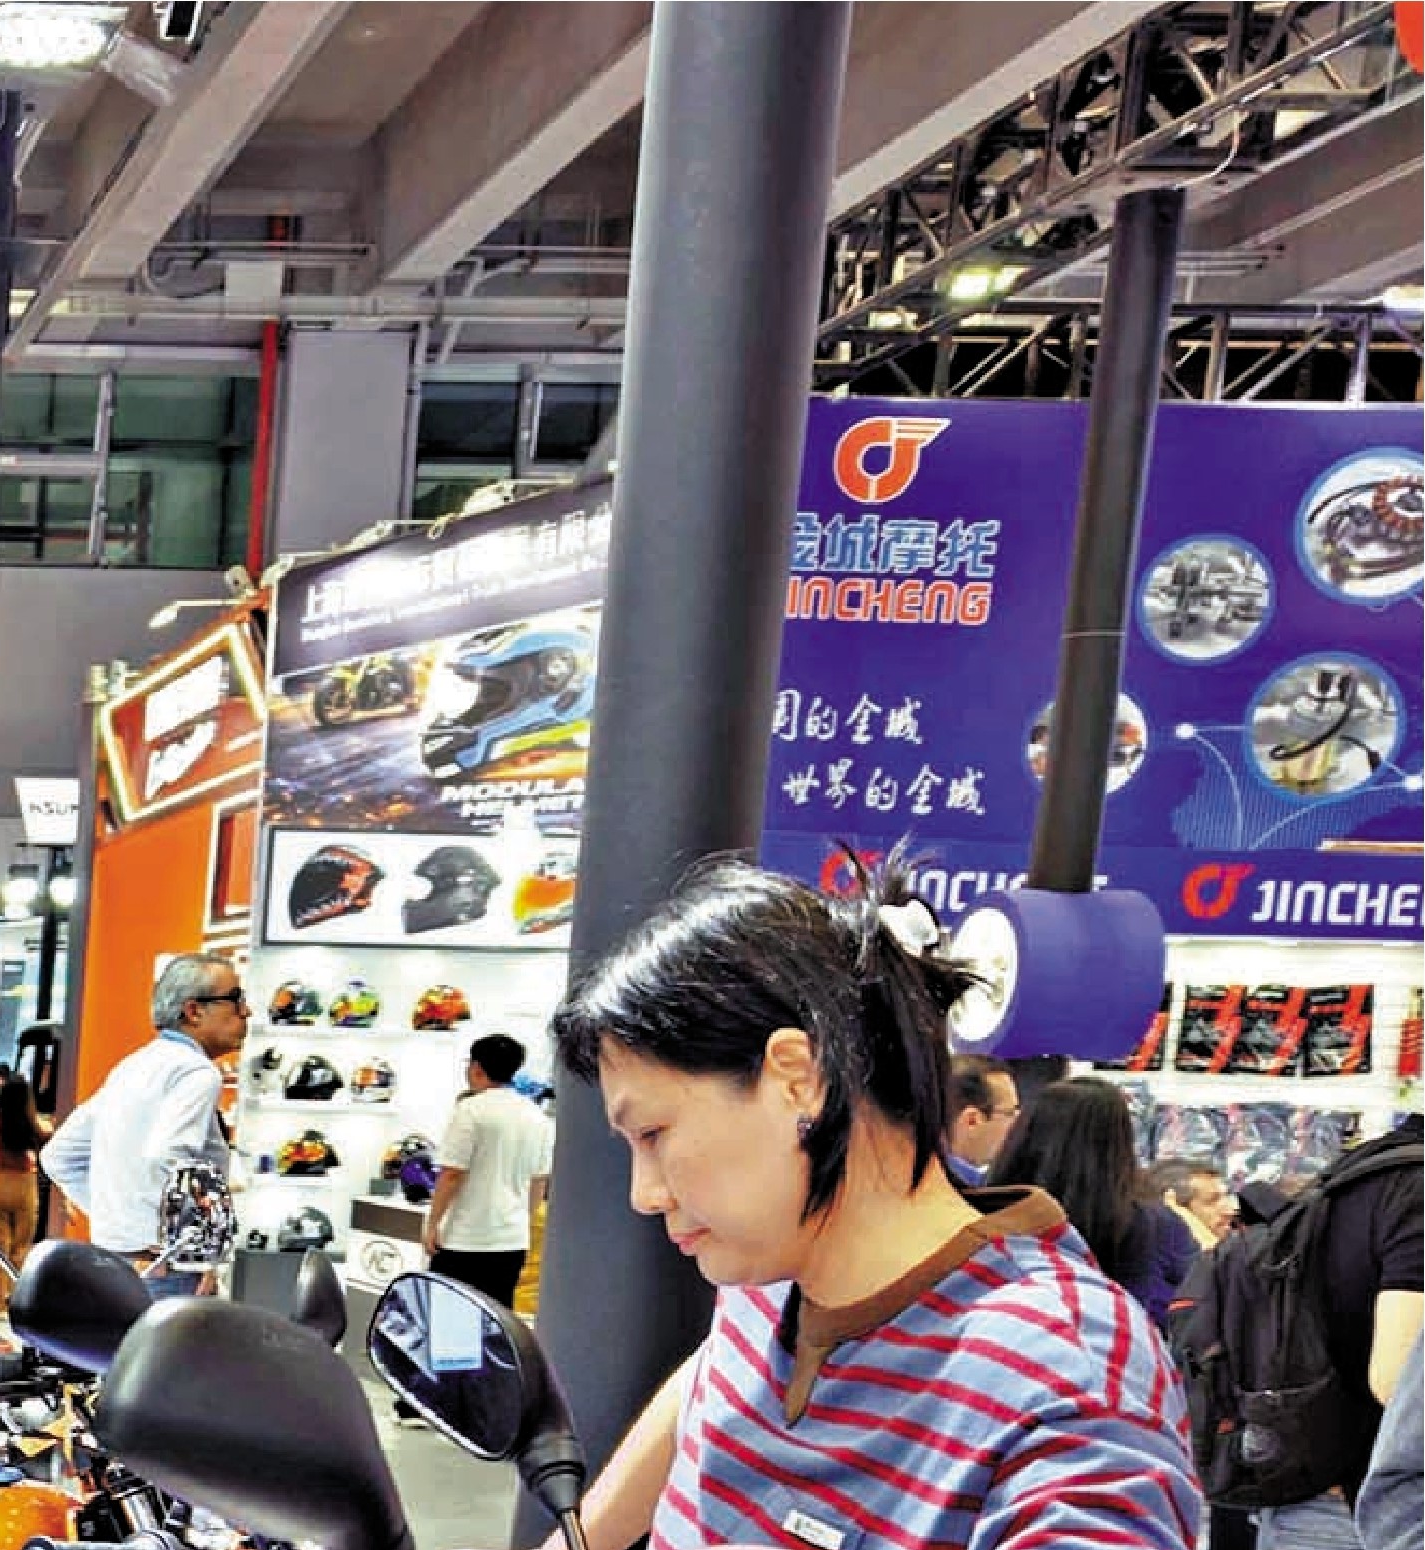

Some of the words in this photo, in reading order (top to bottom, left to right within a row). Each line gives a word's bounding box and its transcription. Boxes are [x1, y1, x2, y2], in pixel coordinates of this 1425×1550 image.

[784, 575, 994, 626] INCHENG
[440, 778, 587, 802] MODULA
[1250, 879, 1425, 927] JINCHE
